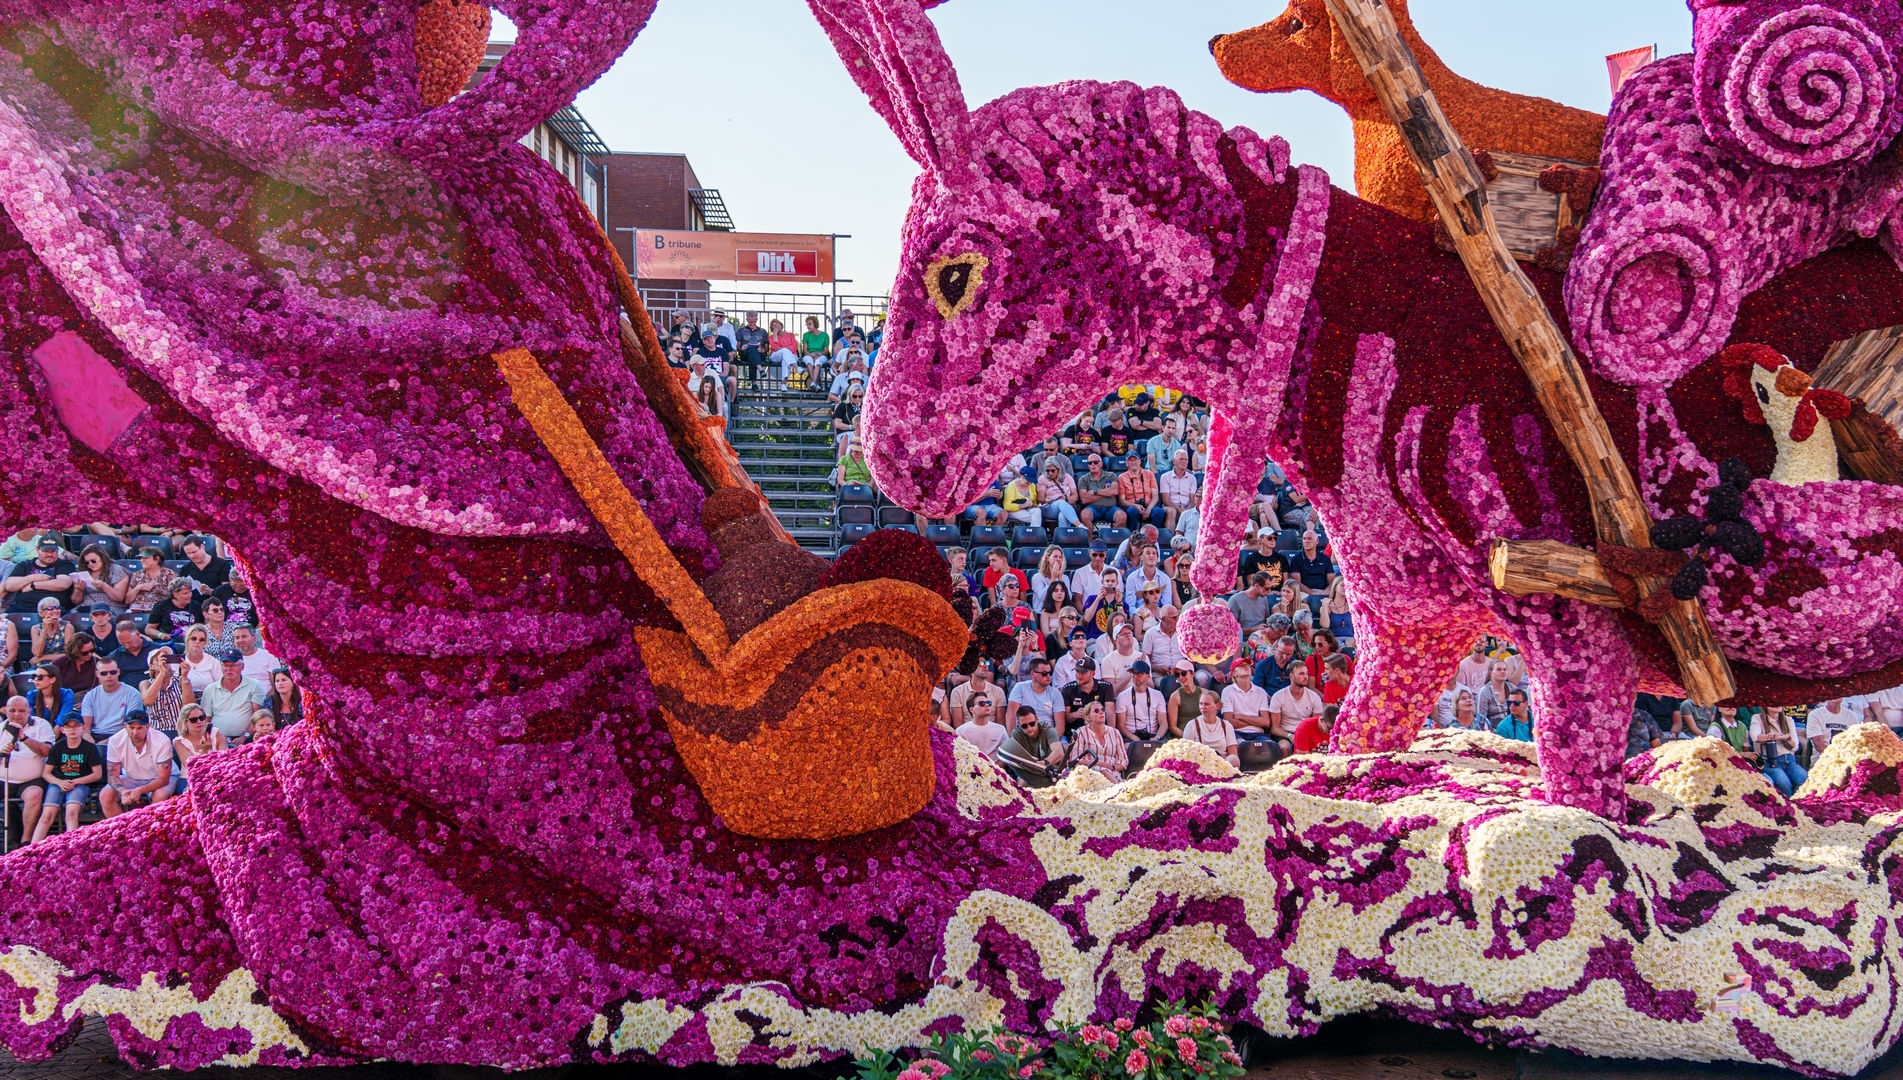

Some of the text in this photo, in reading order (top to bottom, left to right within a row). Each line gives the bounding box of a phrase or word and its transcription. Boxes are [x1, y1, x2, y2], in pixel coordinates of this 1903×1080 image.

[655, 235, 702, 249] B tribune
[757, 251, 796, 272] Dirk
